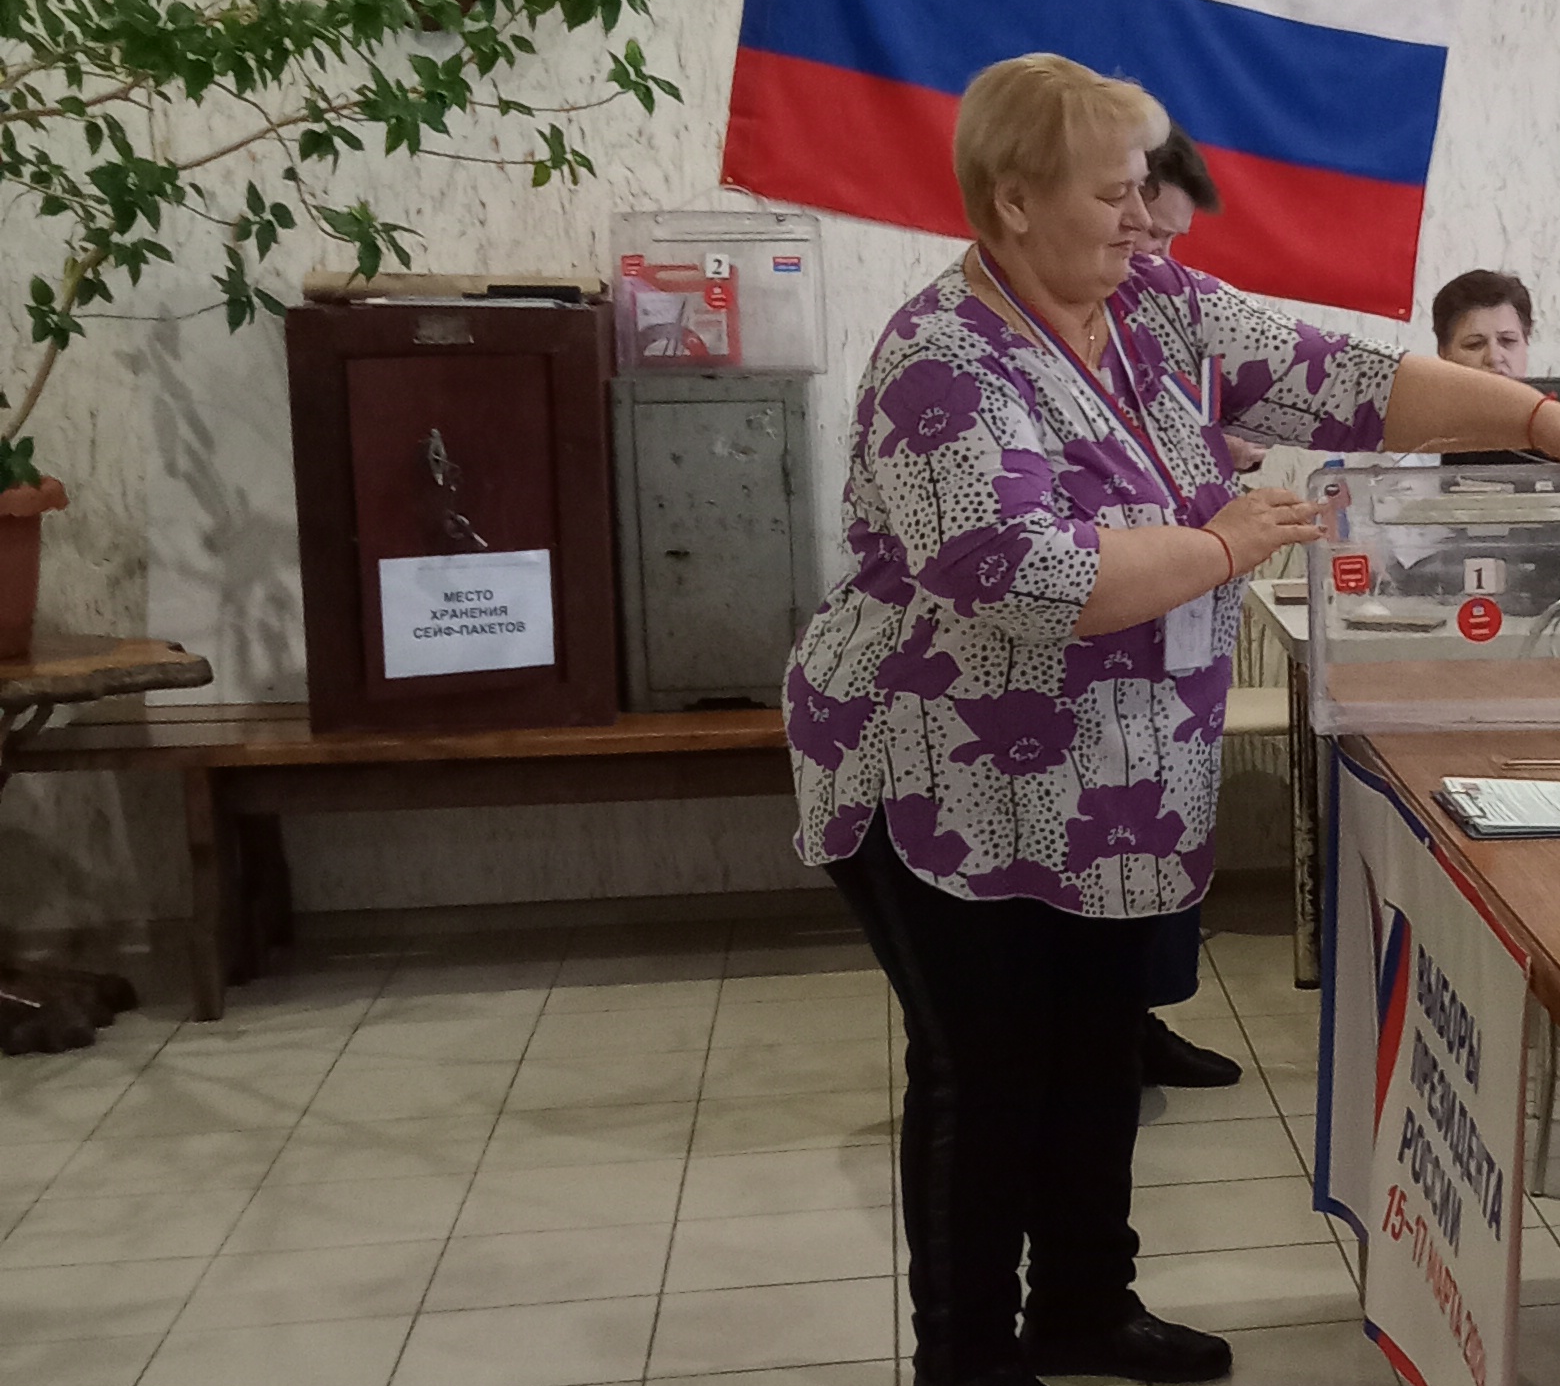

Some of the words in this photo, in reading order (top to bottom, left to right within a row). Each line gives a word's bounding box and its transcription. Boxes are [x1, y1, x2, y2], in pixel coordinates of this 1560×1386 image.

[711, 258, 723, 275] 2
[1473, 566, 1486, 590] 1
[443, 589, 494, 603] МЕСТО
[430, 605, 508, 621] ХРАНЕНИЯ
[412, 621, 527, 640] СЕЙФ-ПАКЕТОВ
[1416, 943, 1482, 1094] ВЫБОРЫ
[1409, 1026, 1504, 1242] ПРЕЗИДЕНТА
[1397, 1106, 1462, 1259] РОССИИ
